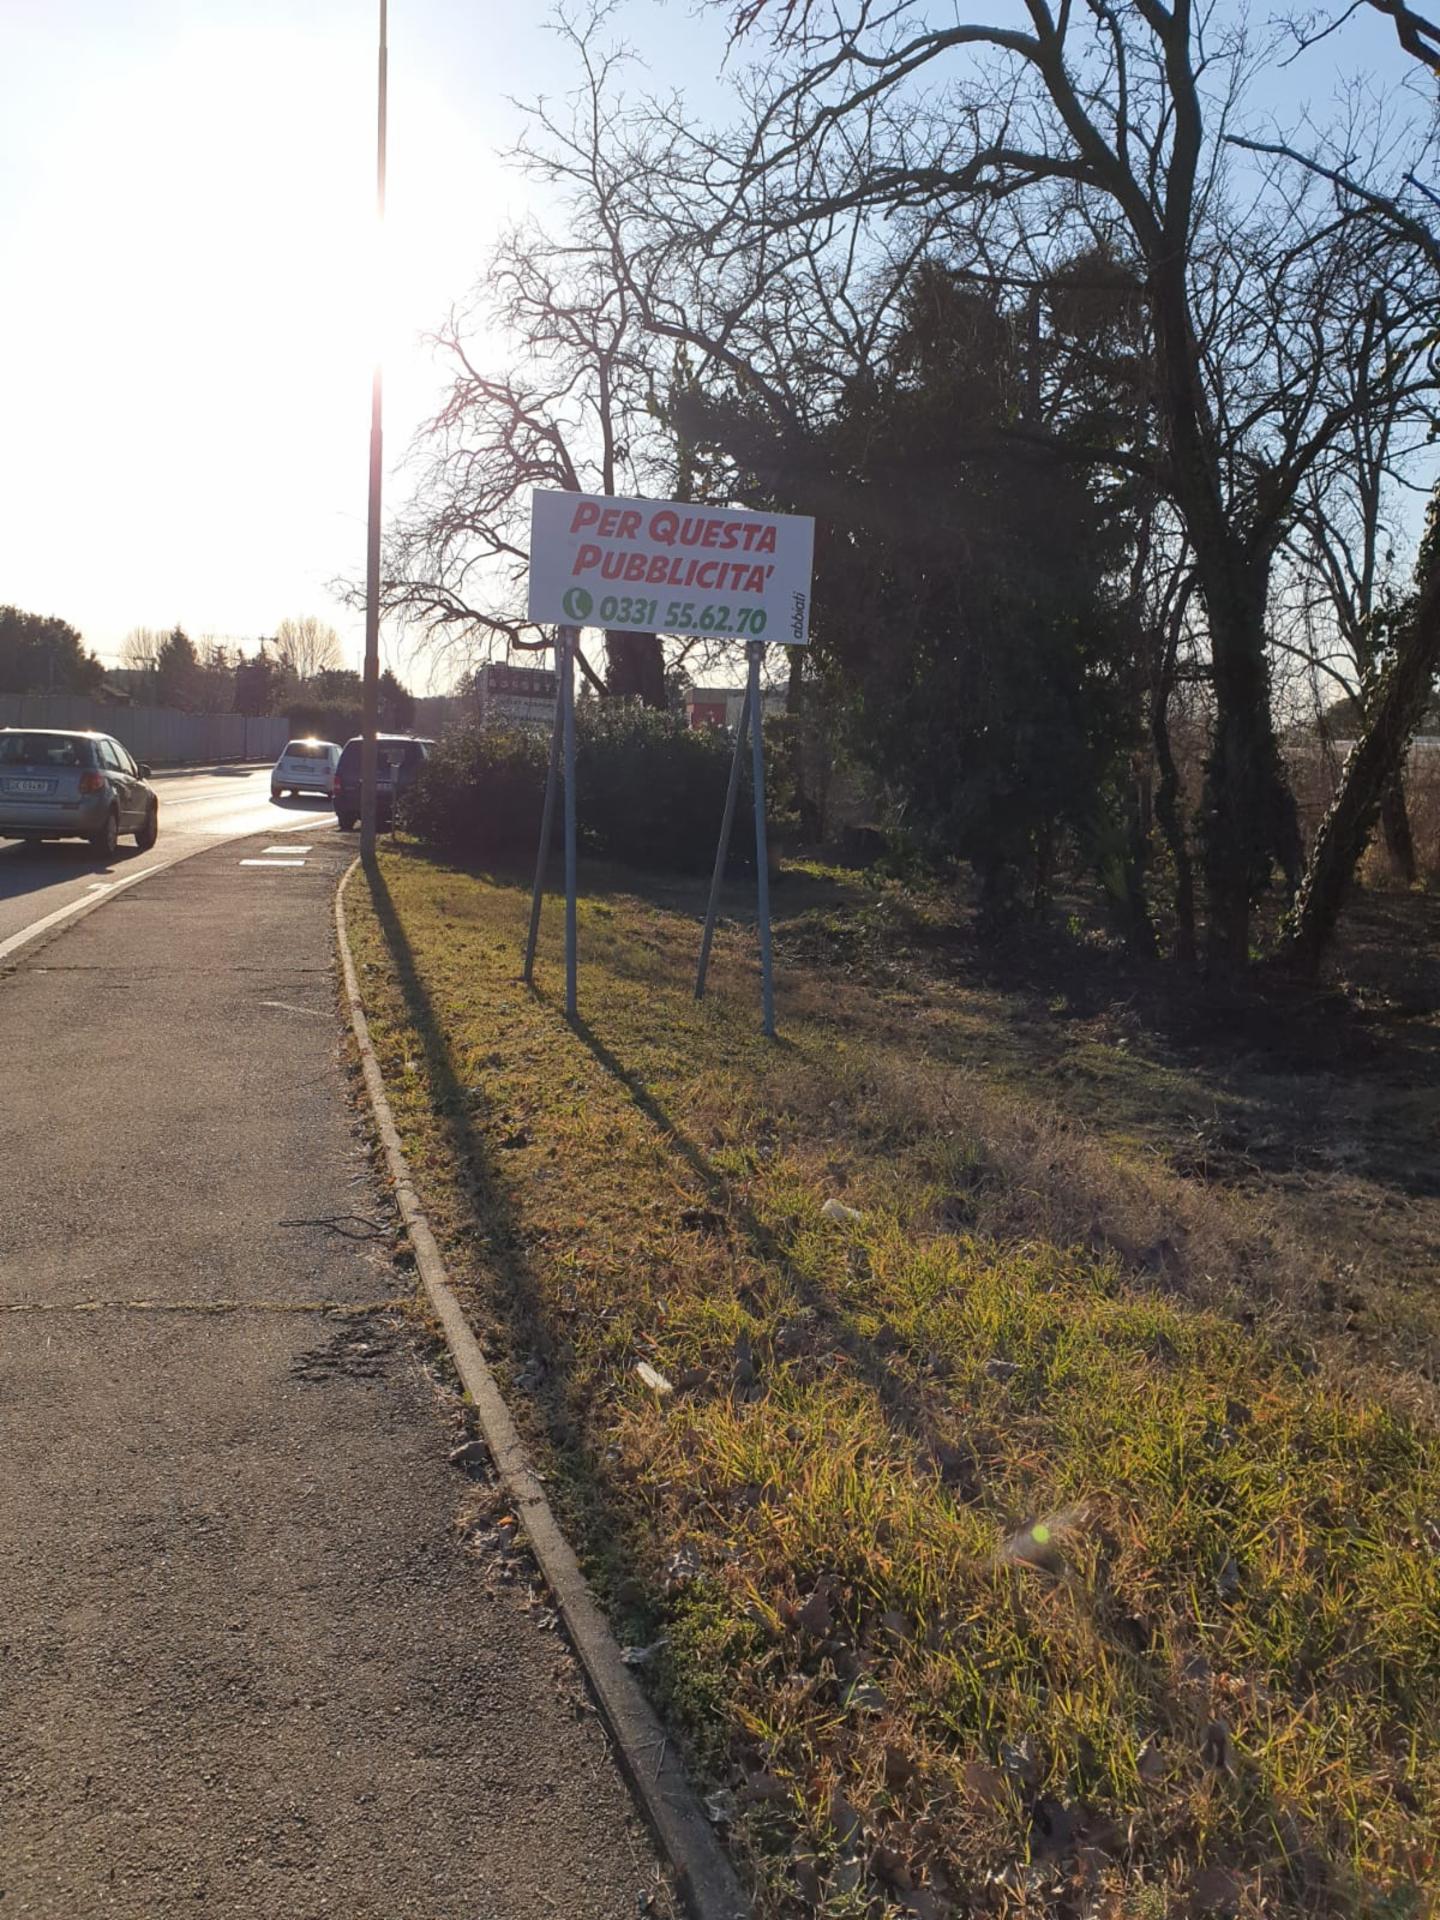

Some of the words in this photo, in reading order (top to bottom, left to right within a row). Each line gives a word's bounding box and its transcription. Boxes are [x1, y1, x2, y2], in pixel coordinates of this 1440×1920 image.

[570, 502, 642, 539] PER
[649, 510, 776, 553] QUESTA
[572, 544, 774, 593] PUBBLICITA'
[600, 596, 657, 622] 0331
[664, 601, 767, 634] 55.62.70
[791, 591, 805, 640] abbiati
